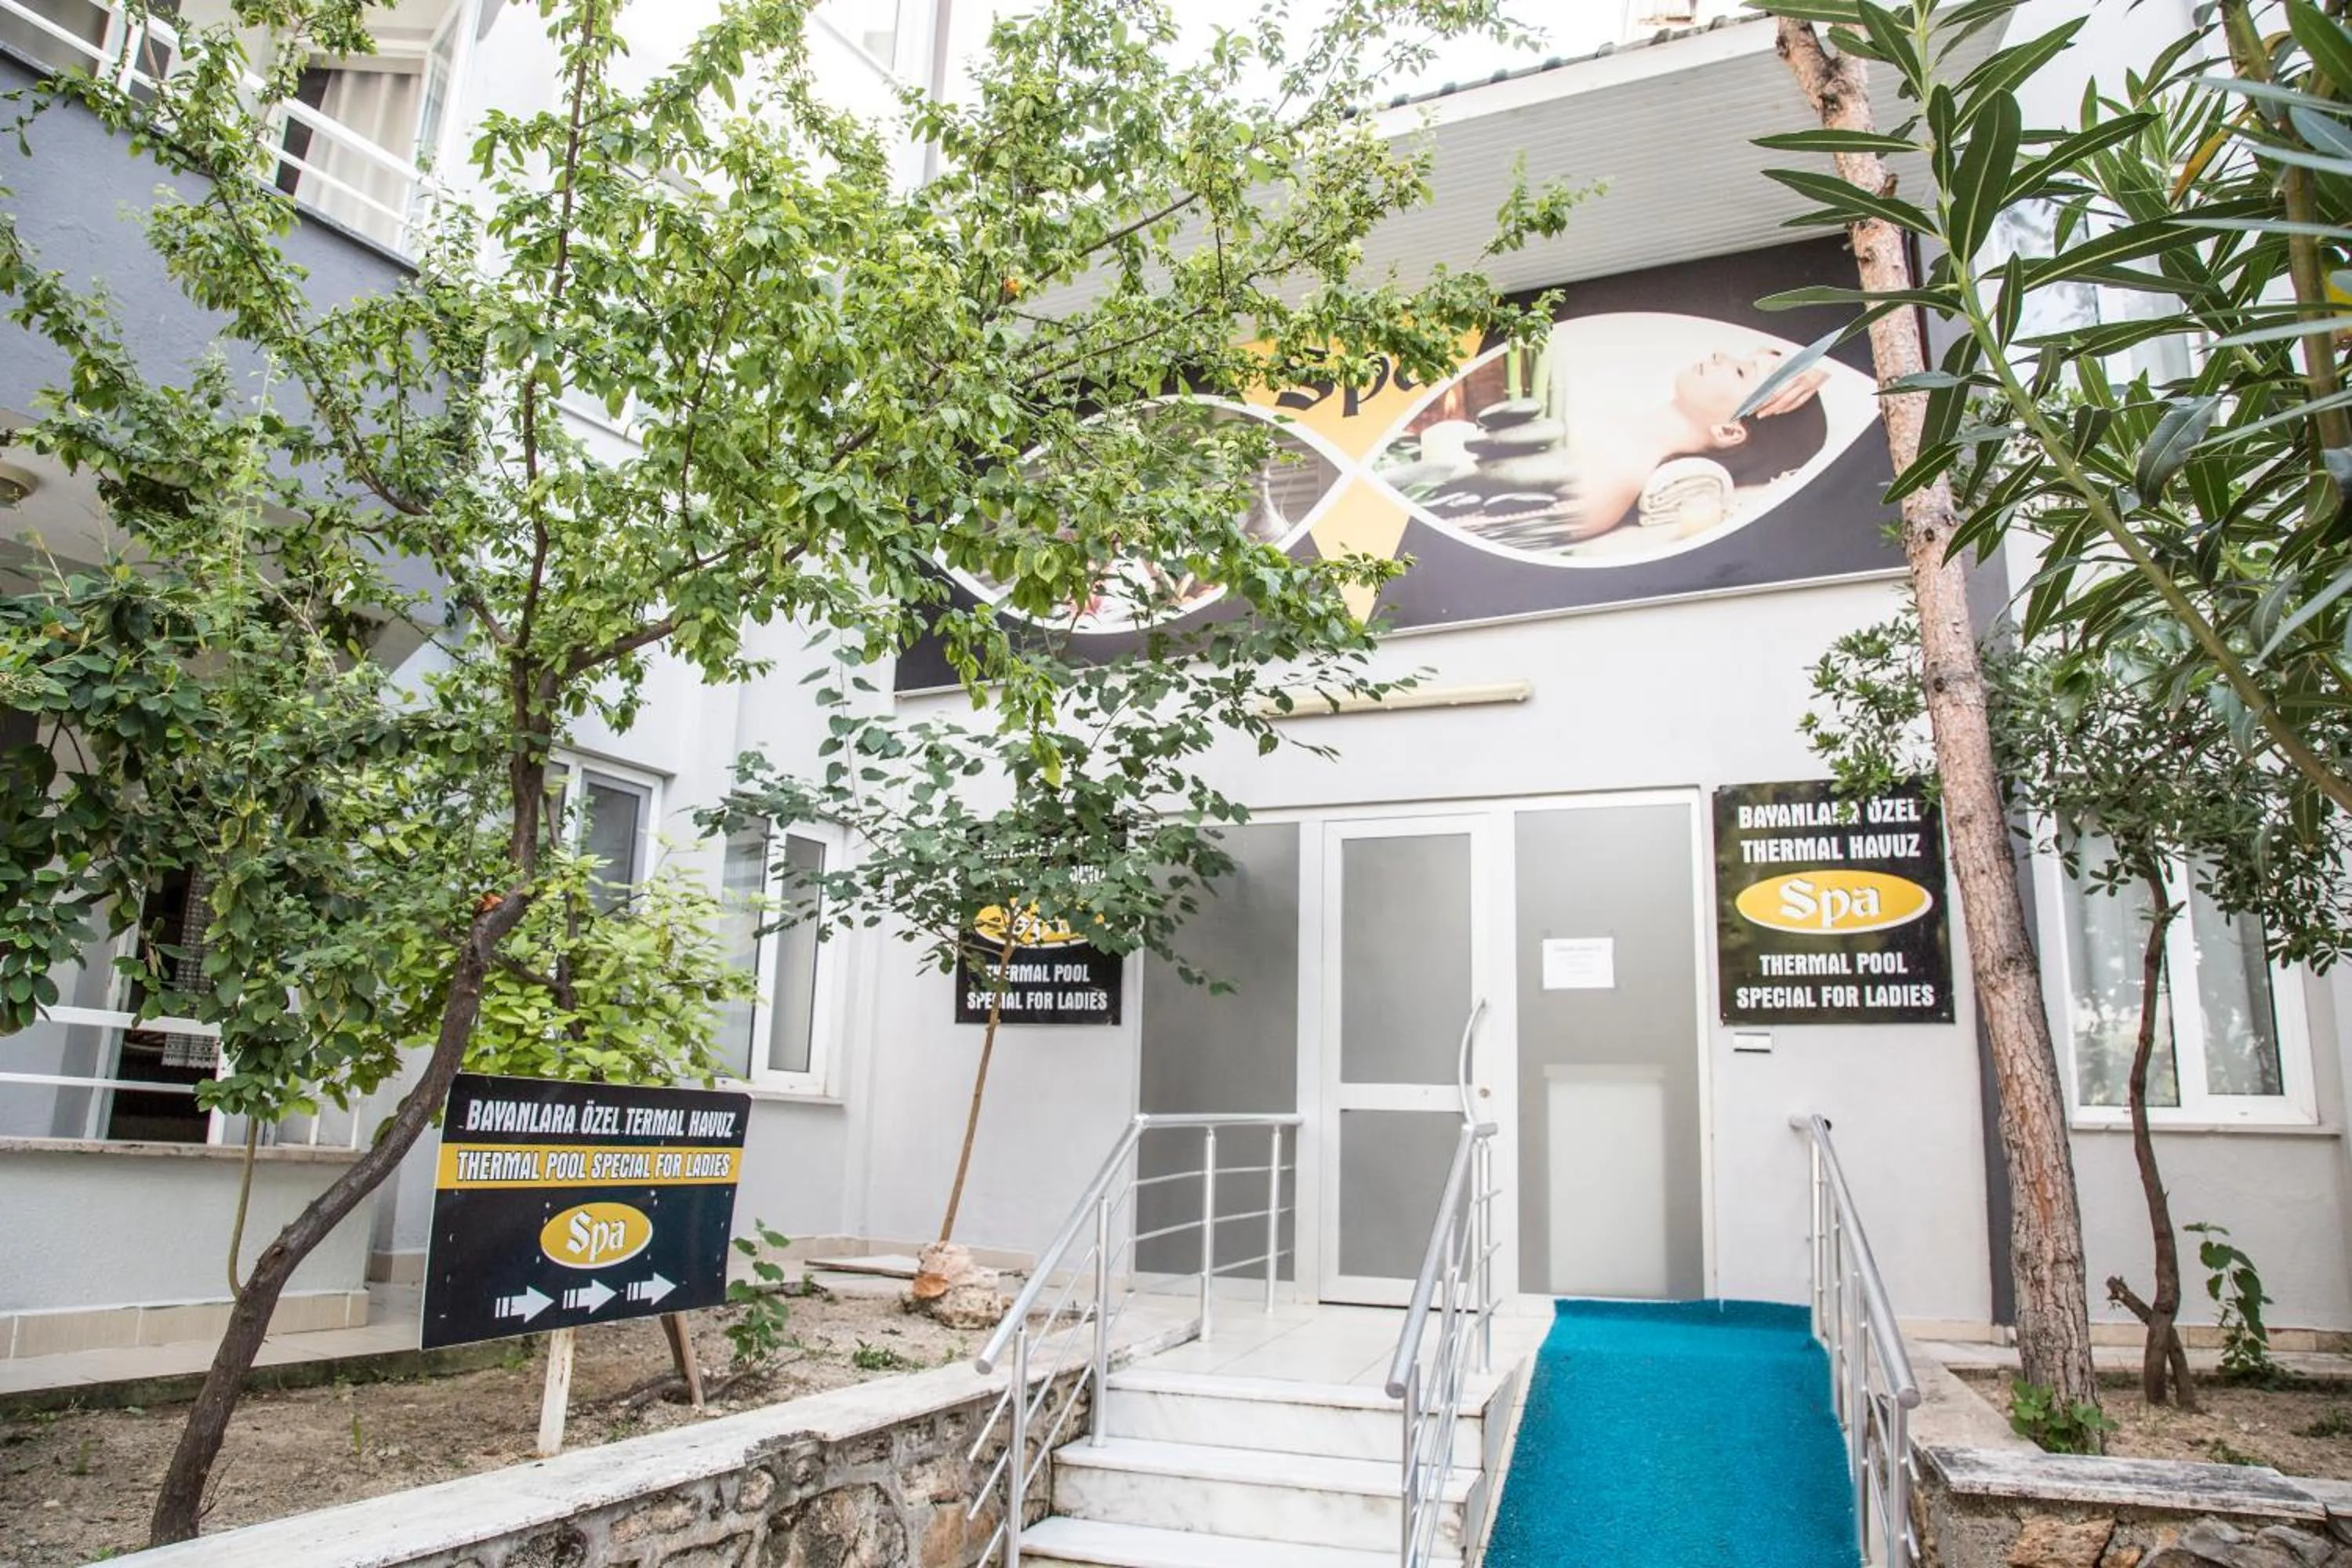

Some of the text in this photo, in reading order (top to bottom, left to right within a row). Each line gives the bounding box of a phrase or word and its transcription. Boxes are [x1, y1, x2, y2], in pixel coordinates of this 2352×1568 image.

[1740, 833, 1922, 863] THERMAL HAVUZ
[1780, 879, 1882, 929] Spa
[1054, 964, 1091, 982] POOL
[1759, 953, 1908, 976] THERMAL POOL
[967, 992, 1108, 1010] SPEIAL FOR LADIES
[1736, 985, 1935, 1009] SPECIAL FOR LADIES
[466, 1098, 736, 1138] BAYANLARA ÖZEL TERMAL HAVUZ
[457, 1151, 731, 1181] THERMAL POOL SPECIAL FOR LADIES
[565, 1210, 626, 1263] Spa
